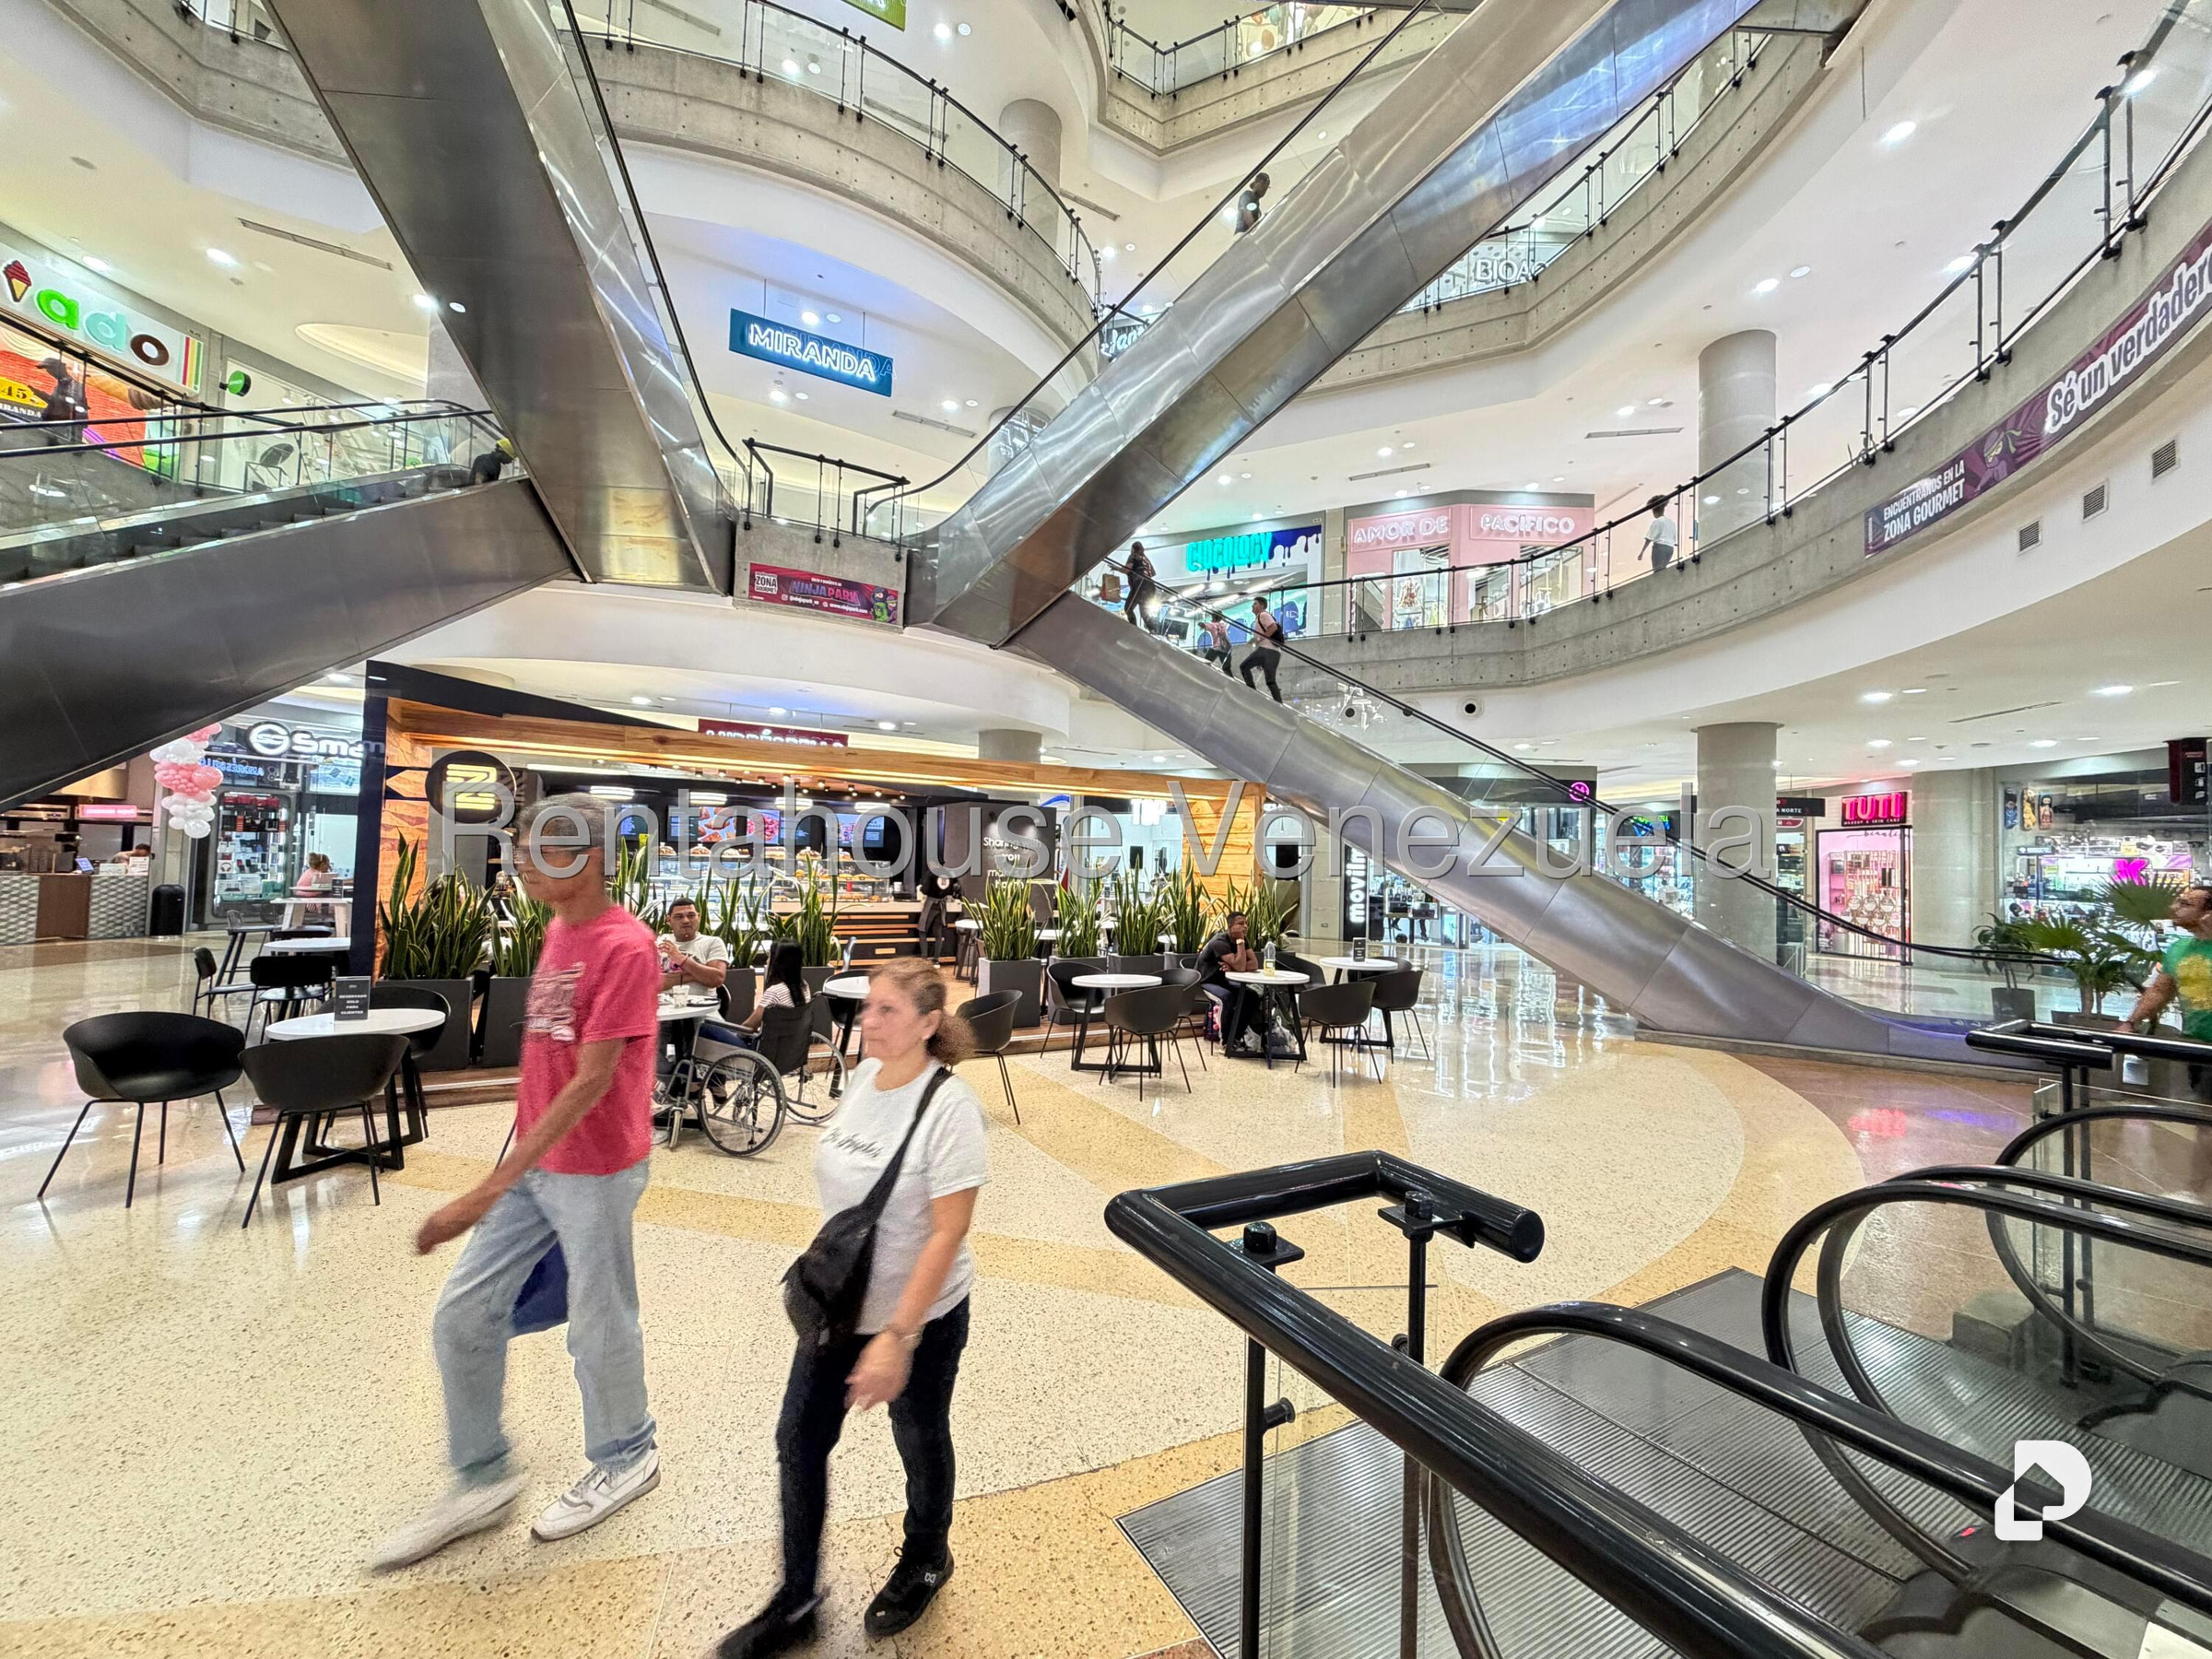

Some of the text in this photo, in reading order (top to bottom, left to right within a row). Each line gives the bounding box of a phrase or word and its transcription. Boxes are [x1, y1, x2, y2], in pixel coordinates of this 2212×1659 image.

[748, 323, 877, 382] MIRANDA
[2051, 376, 2075, 428] Sé
[2080, 360, 2105, 404] un
[1883, 459, 1965, 521] ENCUÉNTRANOS EN LA
[1883, 512, 1912, 543] ZONA
[1912, 477, 1965, 526] GOURMET
[1354, 515, 1448, 544] AMOR DE
[756, 576, 777, 588] ZONA
[791, 581, 828, 597] NINJA
[828, 588, 861, 605] PARK
